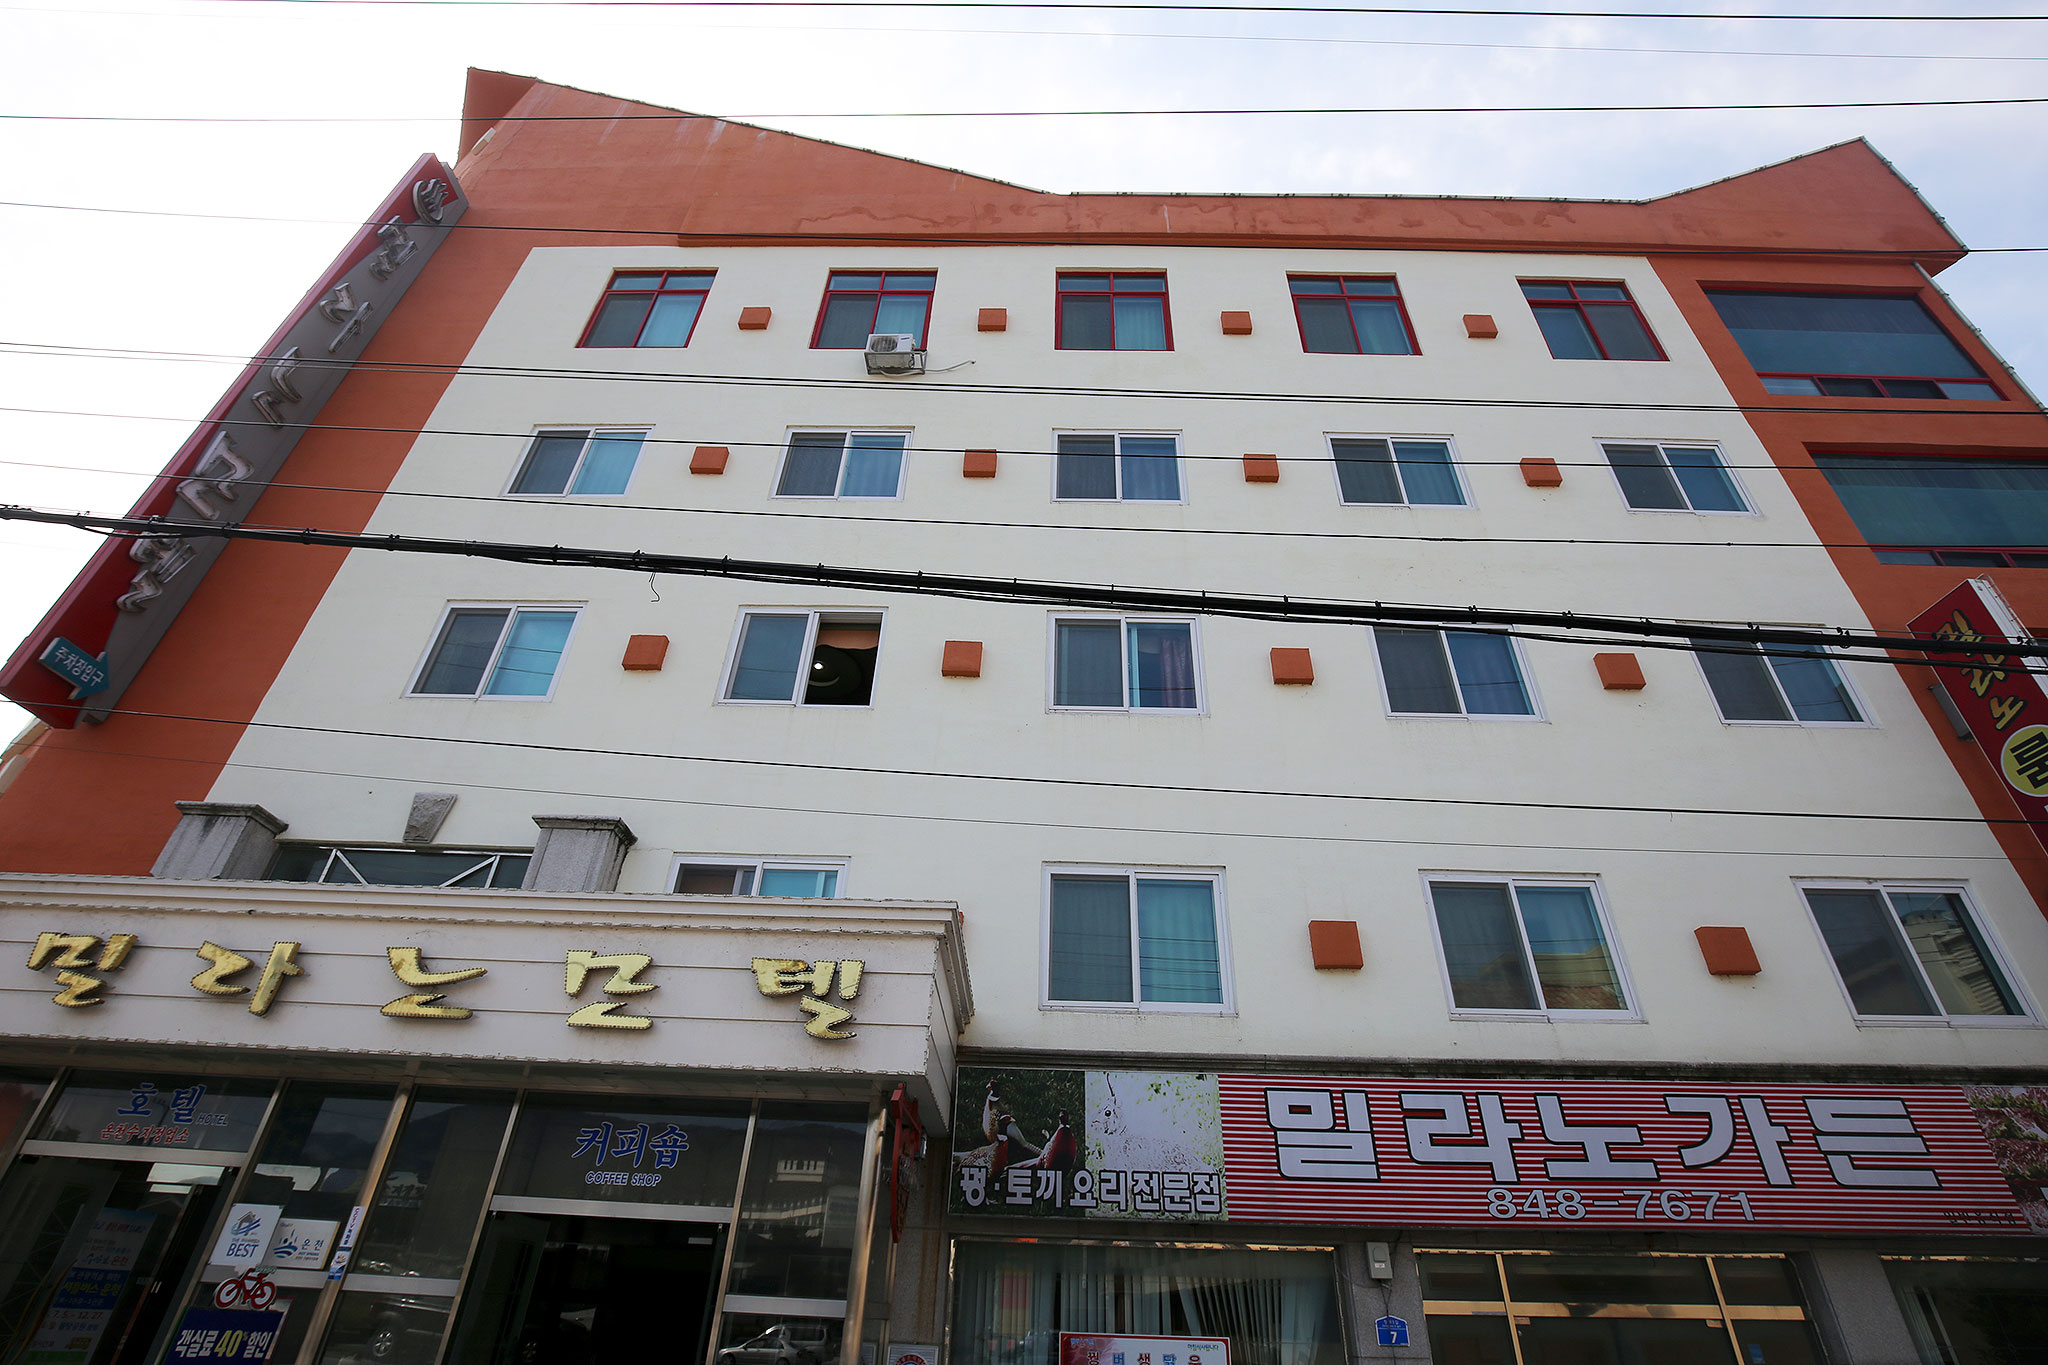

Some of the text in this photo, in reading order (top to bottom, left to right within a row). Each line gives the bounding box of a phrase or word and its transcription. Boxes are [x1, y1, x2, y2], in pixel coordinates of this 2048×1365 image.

[55, 646, 105, 687] 주차장입구
[117, 1083, 207, 1125] 호텔
[196, 1113, 229, 1126] HOTEL
[571, 1122, 689, 1169] 커피숍
[1265, 1087, 1942, 1190] 밀라노가든
[585, 1171, 661, 1187] COFFEE SHOP
[1485, 1188, 1756, 1222] 848-7671
[226, 1243, 259, 1257] BEST
[175, 1329, 219, 1358] 객실료
[243, 1331, 272, 1358] 할인
[1390, 1331, 1397, 1344] 7
